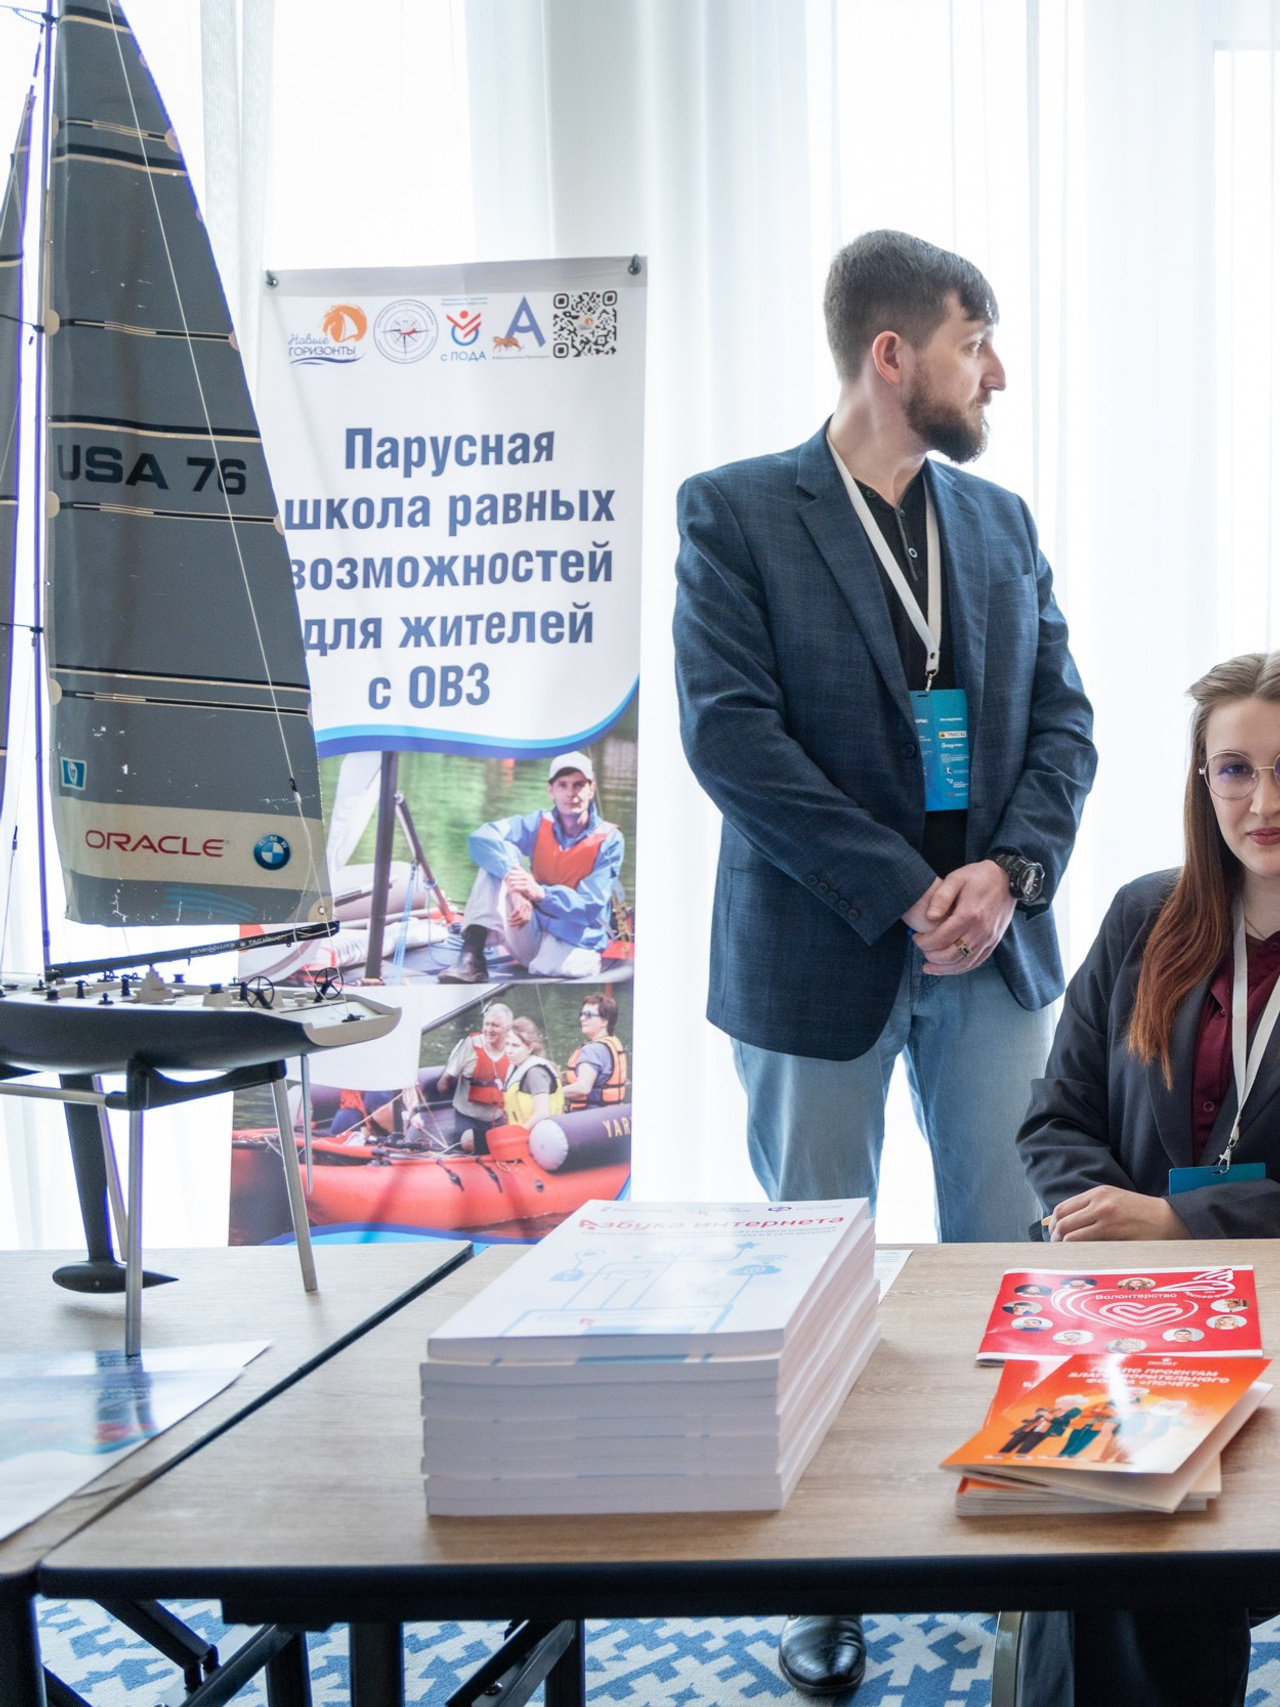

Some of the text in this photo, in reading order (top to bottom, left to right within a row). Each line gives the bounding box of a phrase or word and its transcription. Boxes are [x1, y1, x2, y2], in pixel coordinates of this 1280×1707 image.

[288, 346, 356, 357] ГОРИЗОНТЫ
[450, 351, 487, 362] ПОДА
[57, 444, 247, 496] USA 76
[344, 427, 555, 478] Парусная
[284, 489, 616, 537] школа равных
[290, 541, 614, 591] возможностей
[304, 601, 594, 657] для жителей
[368, 662, 491, 710] с ОВЗ
[85, 829, 225, 858] ORACLE
[579, 1217, 843, 1230] Азбука интернета
[1145, 1368, 1219, 1377] ПРОЕКТАМ
